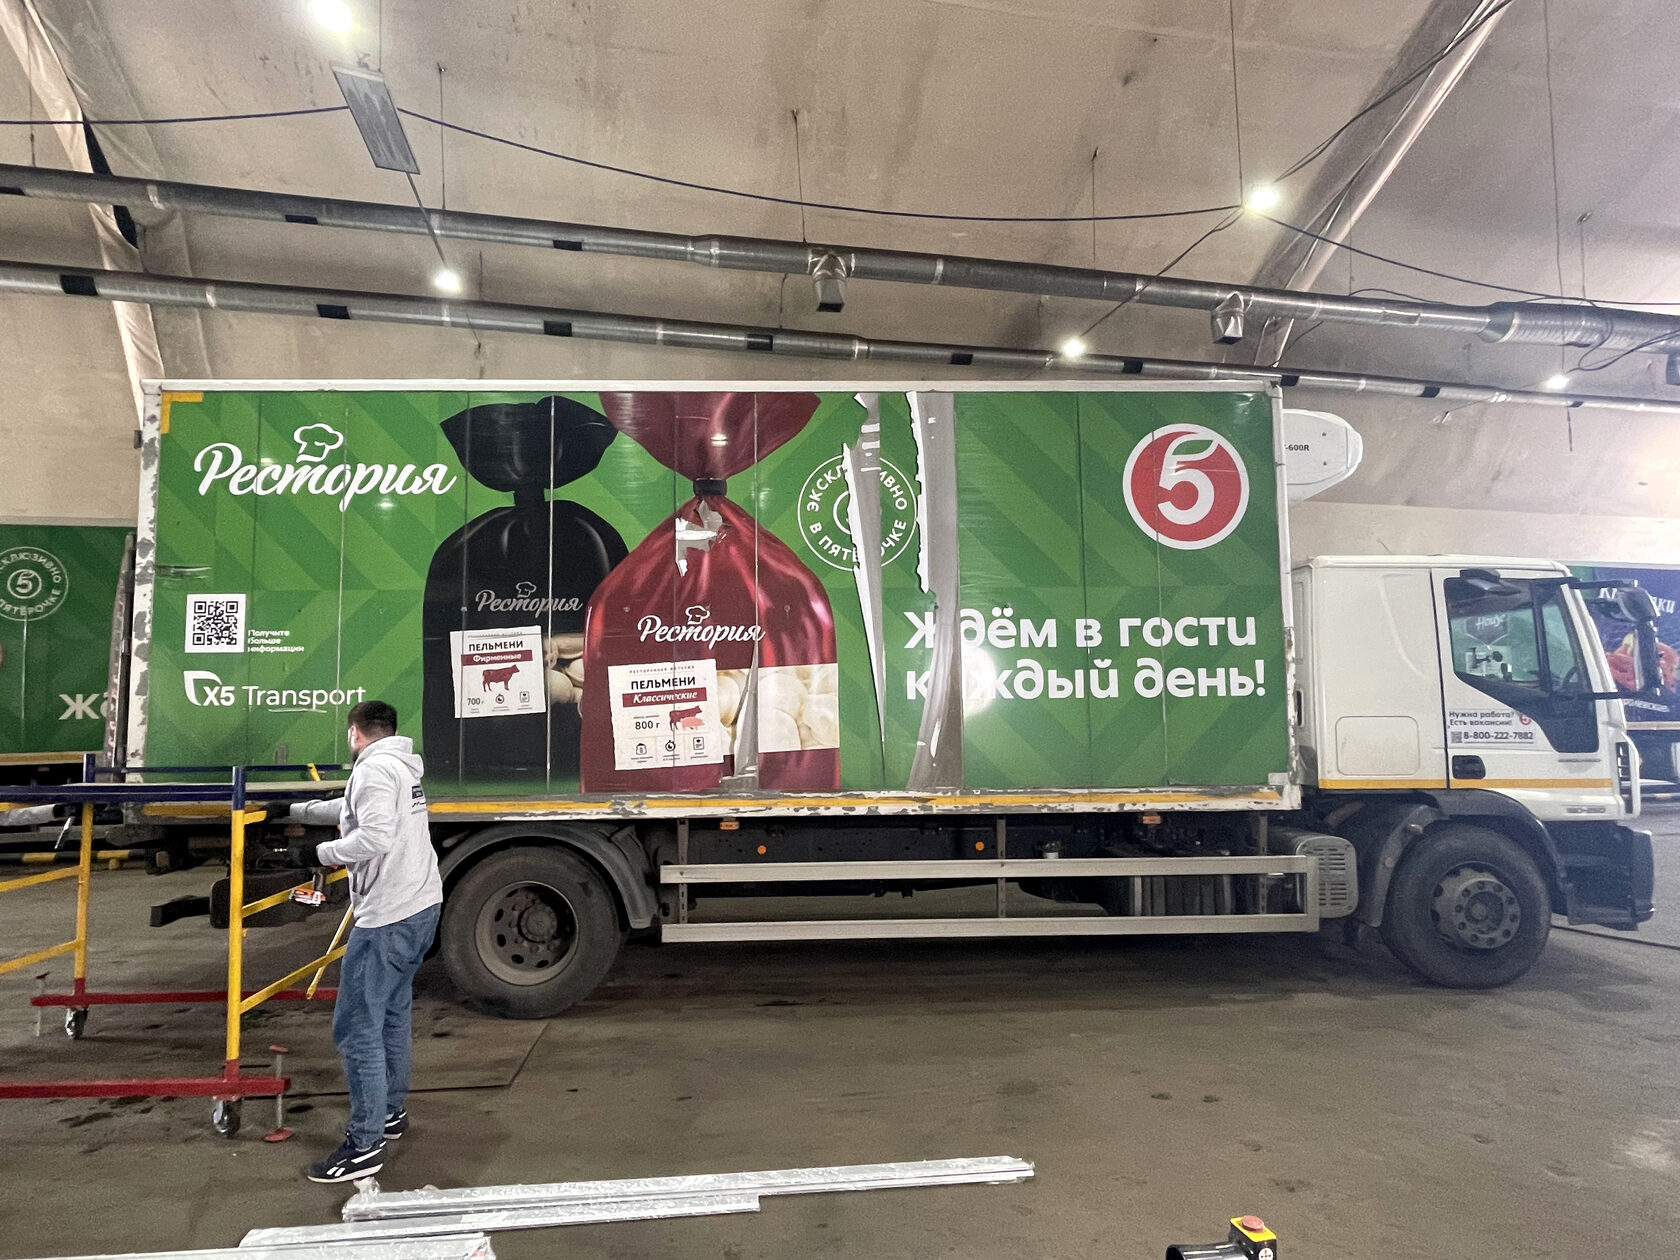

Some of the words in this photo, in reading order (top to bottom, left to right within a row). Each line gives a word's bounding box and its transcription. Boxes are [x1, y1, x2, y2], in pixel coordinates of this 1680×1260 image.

[194, 442, 457, 512] Рестория
[809, 522, 823, 534] В
[475, 589, 583, 618] Рестория
[248, 630, 290, 638] Получите
[637, 615, 765, 650] Рестория
[1075, 618, 1102, 647] в
[1119, 616, 1256, 647] гости
[248, 637, 281, 645] больше
[469, 640, 523, 651] ПЕЛЬМЕНИ
[248, 645, 304, 653] информации
[473, 653, 522, 663] Фирменные
[631, 676, 696, 690] ПЕЛЬМЕНИ
[906, 658, 1119, 700] кждый
[1134, 657, 1266, 698] день!
[242, 686, 366, 710] Transport
[467, 698, 480, 706] 700
[633, 692, 698, 704] Классические
[1480, 711, 1514, 719] работа?
[635, 720, 654, 730] 800
